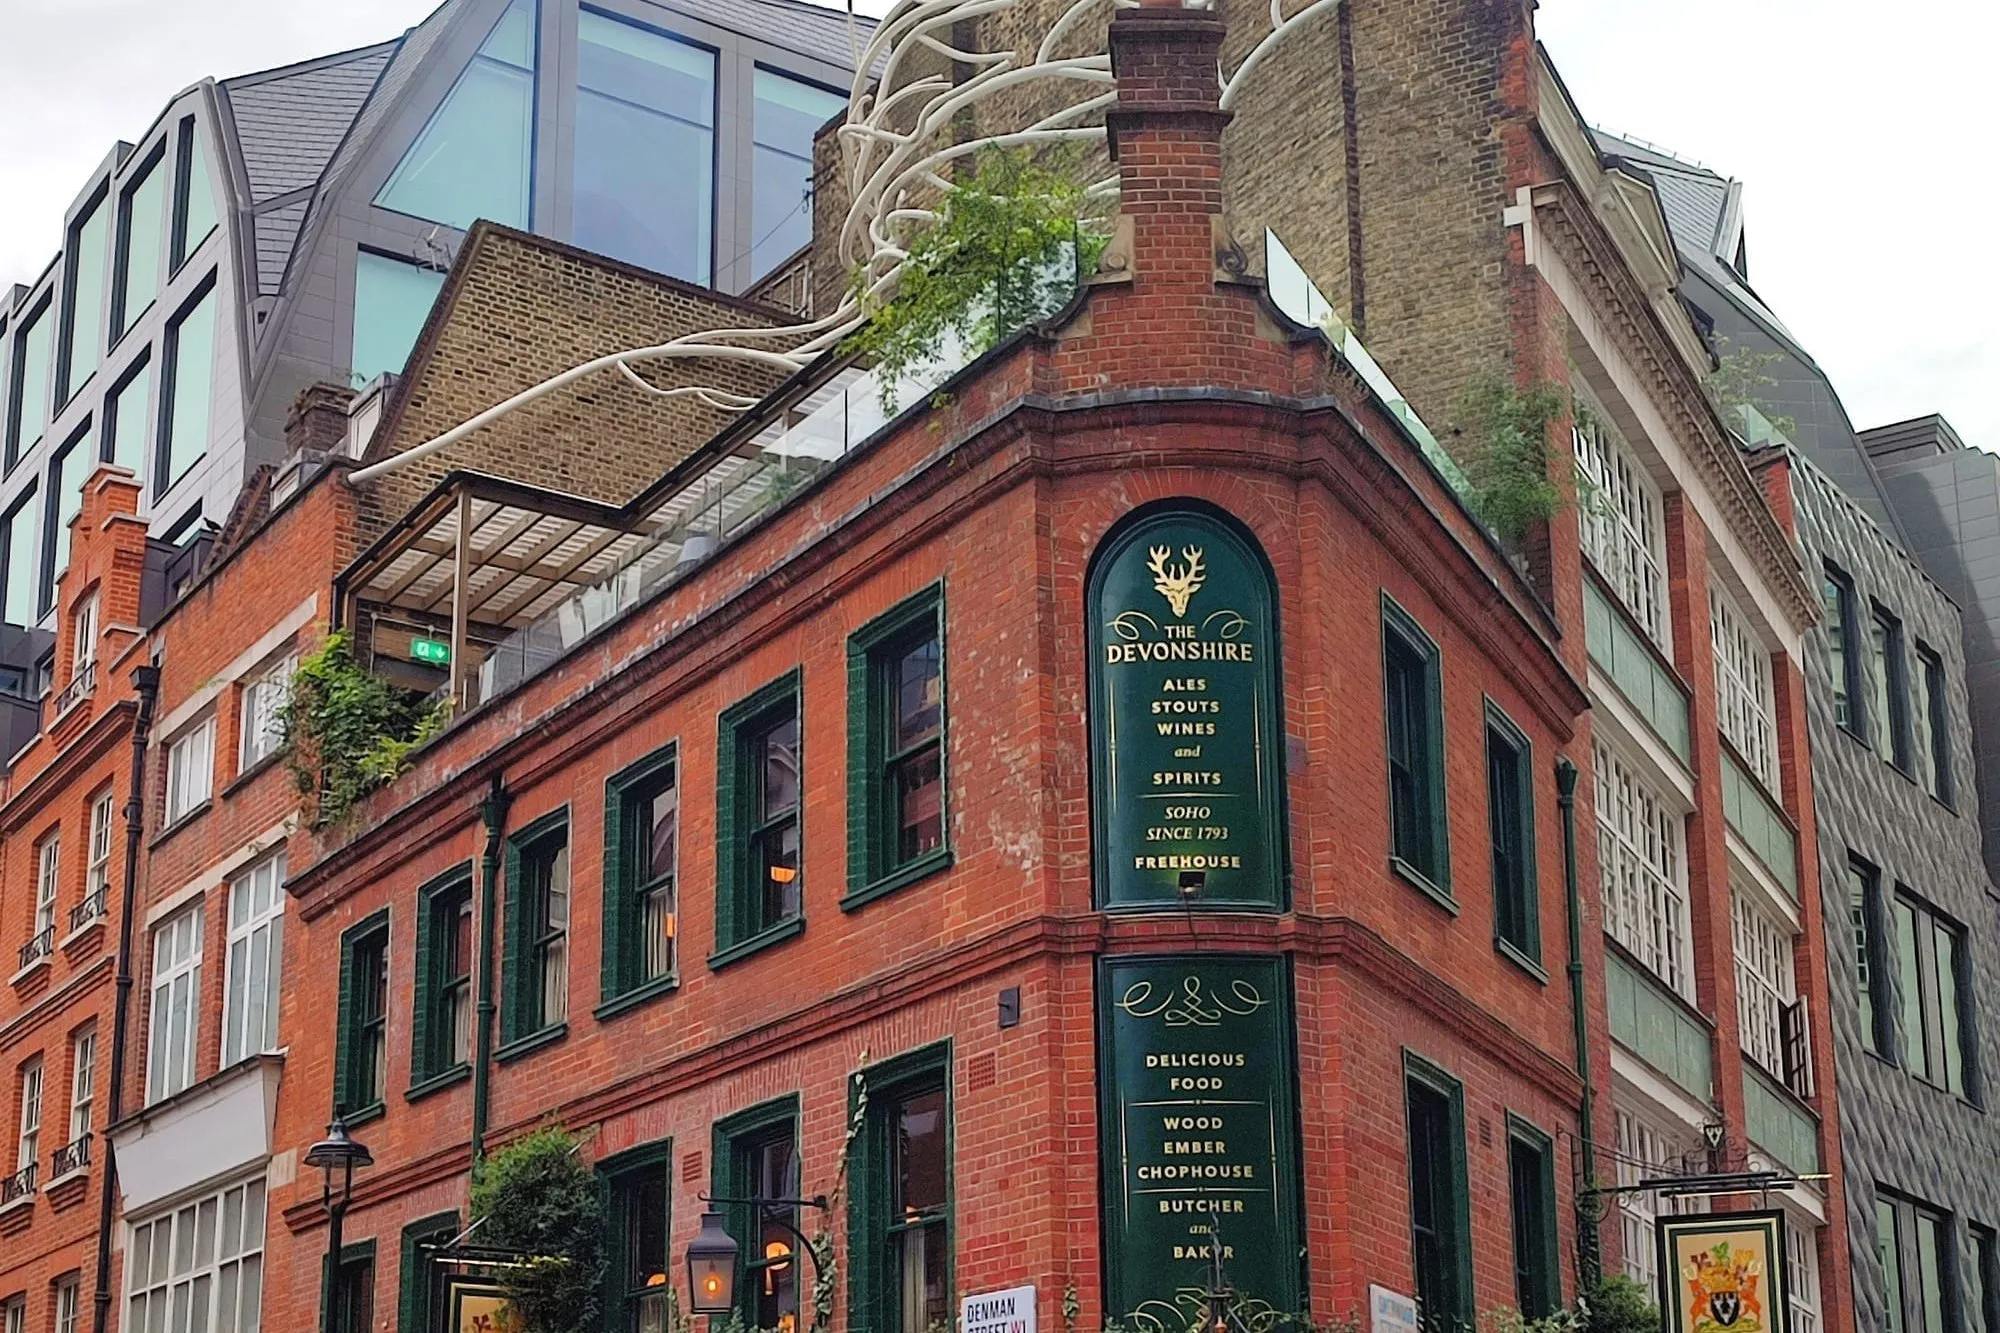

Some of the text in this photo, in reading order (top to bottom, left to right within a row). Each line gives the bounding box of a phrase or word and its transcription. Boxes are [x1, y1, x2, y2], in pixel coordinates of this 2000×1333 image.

[1165, 625, 1196, 639] THE
[1107, 642, 1252, 664] DEVONSHIRE
[1163, 678, 1206, 692] ALES
[1151, 701, 1219, 714] STOUTS
[1157, 722, 1215, 736] WINES
[1174, 744, 1201, 758] and
[1153, 772, 1221, 785] SPIRITS
[1165, 806, 1211, 820] SOHO
[1146, 826, 1228, 841] SINCE 1793
[1135, 856, 1241, 869] FREEHOUSE
[1146, 1054, 1245, 1068] DELICIOUS
[1170, 1077, 1223, 1091] FOOD
[1163, 1117, 1223, 1130] WOOD
[1163, 1141, 1226, 1154] EMBER
[1137, 1165, 1254, 1180] CHOPHOUSE
[1159, 1199, 1244, 1213] BUTCHER
[1173, 1245, 1234, 1259] BAKR
[967, 1297, 1015, 1323] DENMAN
